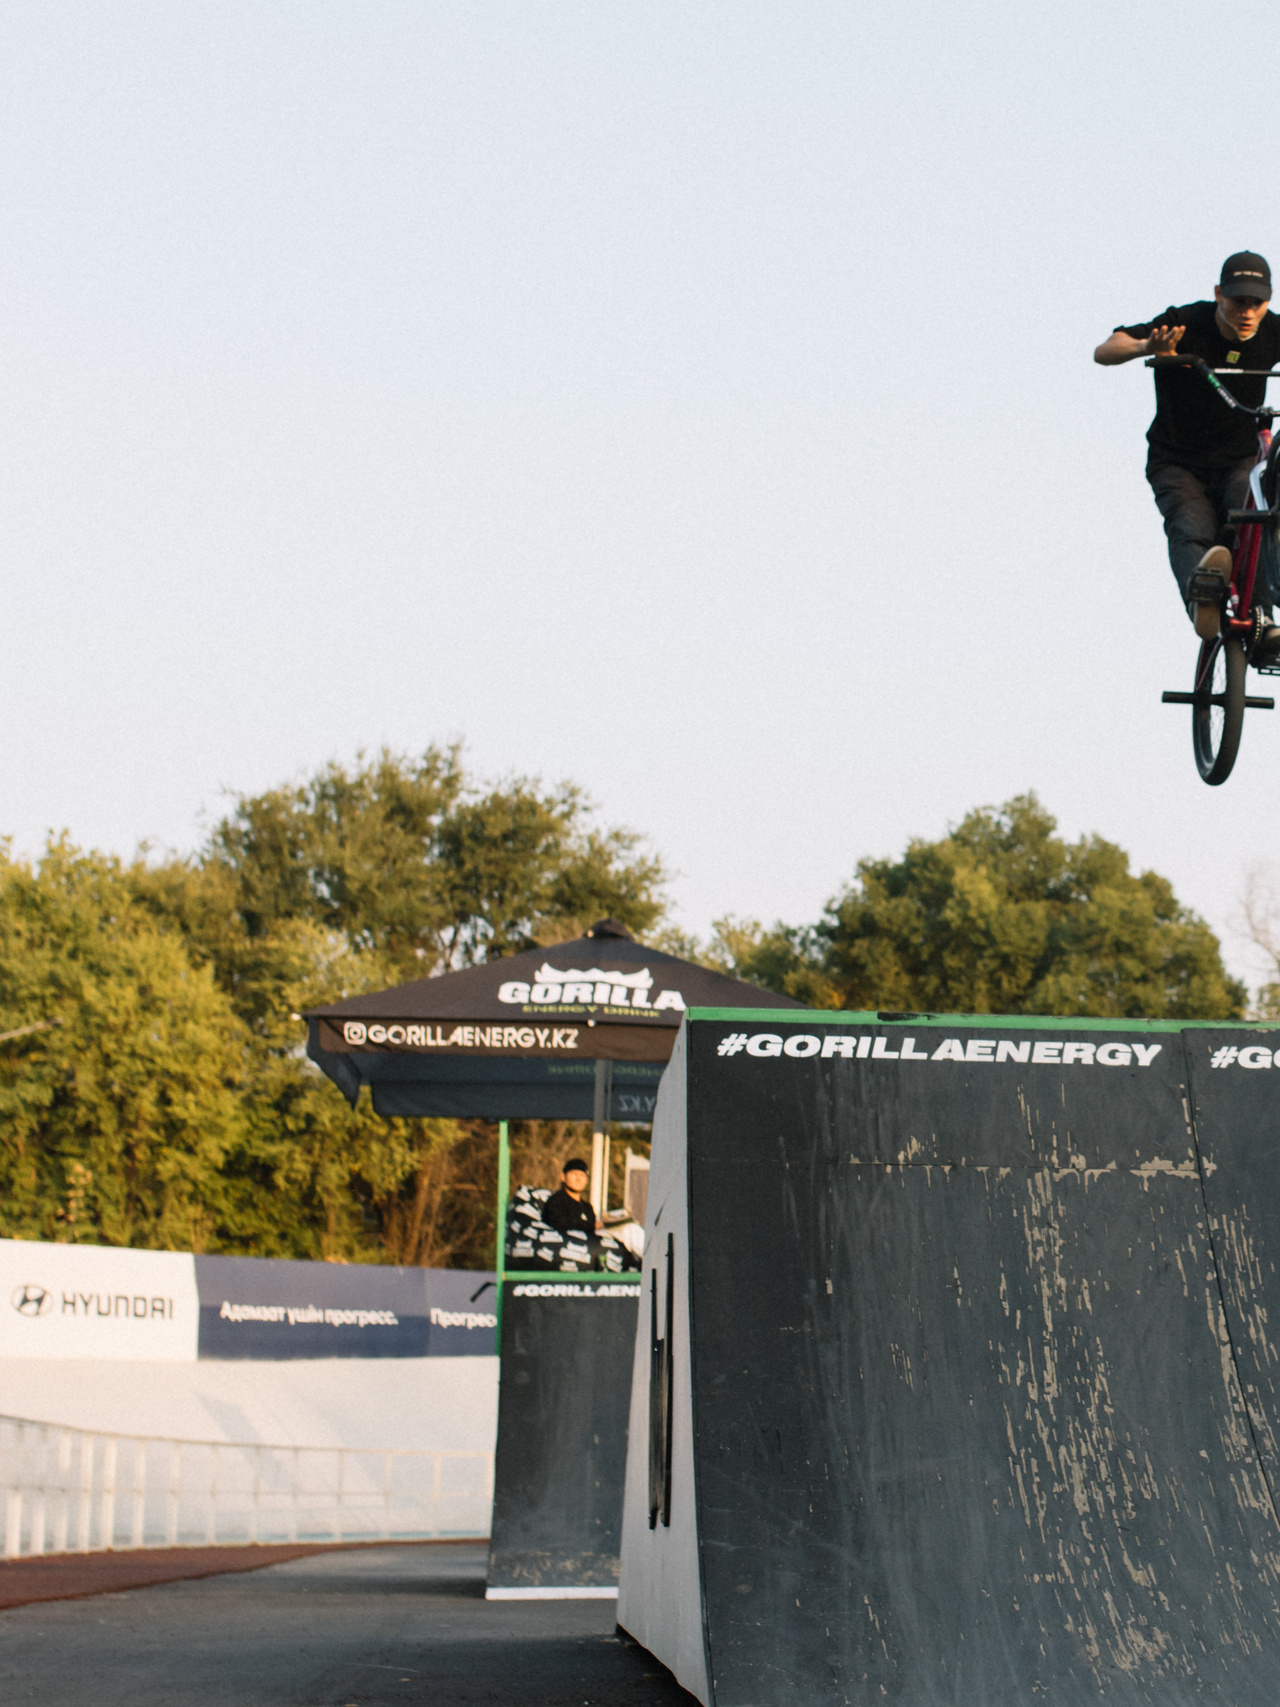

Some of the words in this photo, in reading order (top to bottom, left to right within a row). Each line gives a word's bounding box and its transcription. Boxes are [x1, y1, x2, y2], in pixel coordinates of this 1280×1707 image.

[498, 981, 687, 1011] GORILLA
[522, 1004, 598, 1014] ENERGY
[603, 1007, 661, 1018] DRINK
[717, 1033, 1162, 1067] #GORILLAENERGY
[62, 1292, 174, 1320] HYUNDAI
